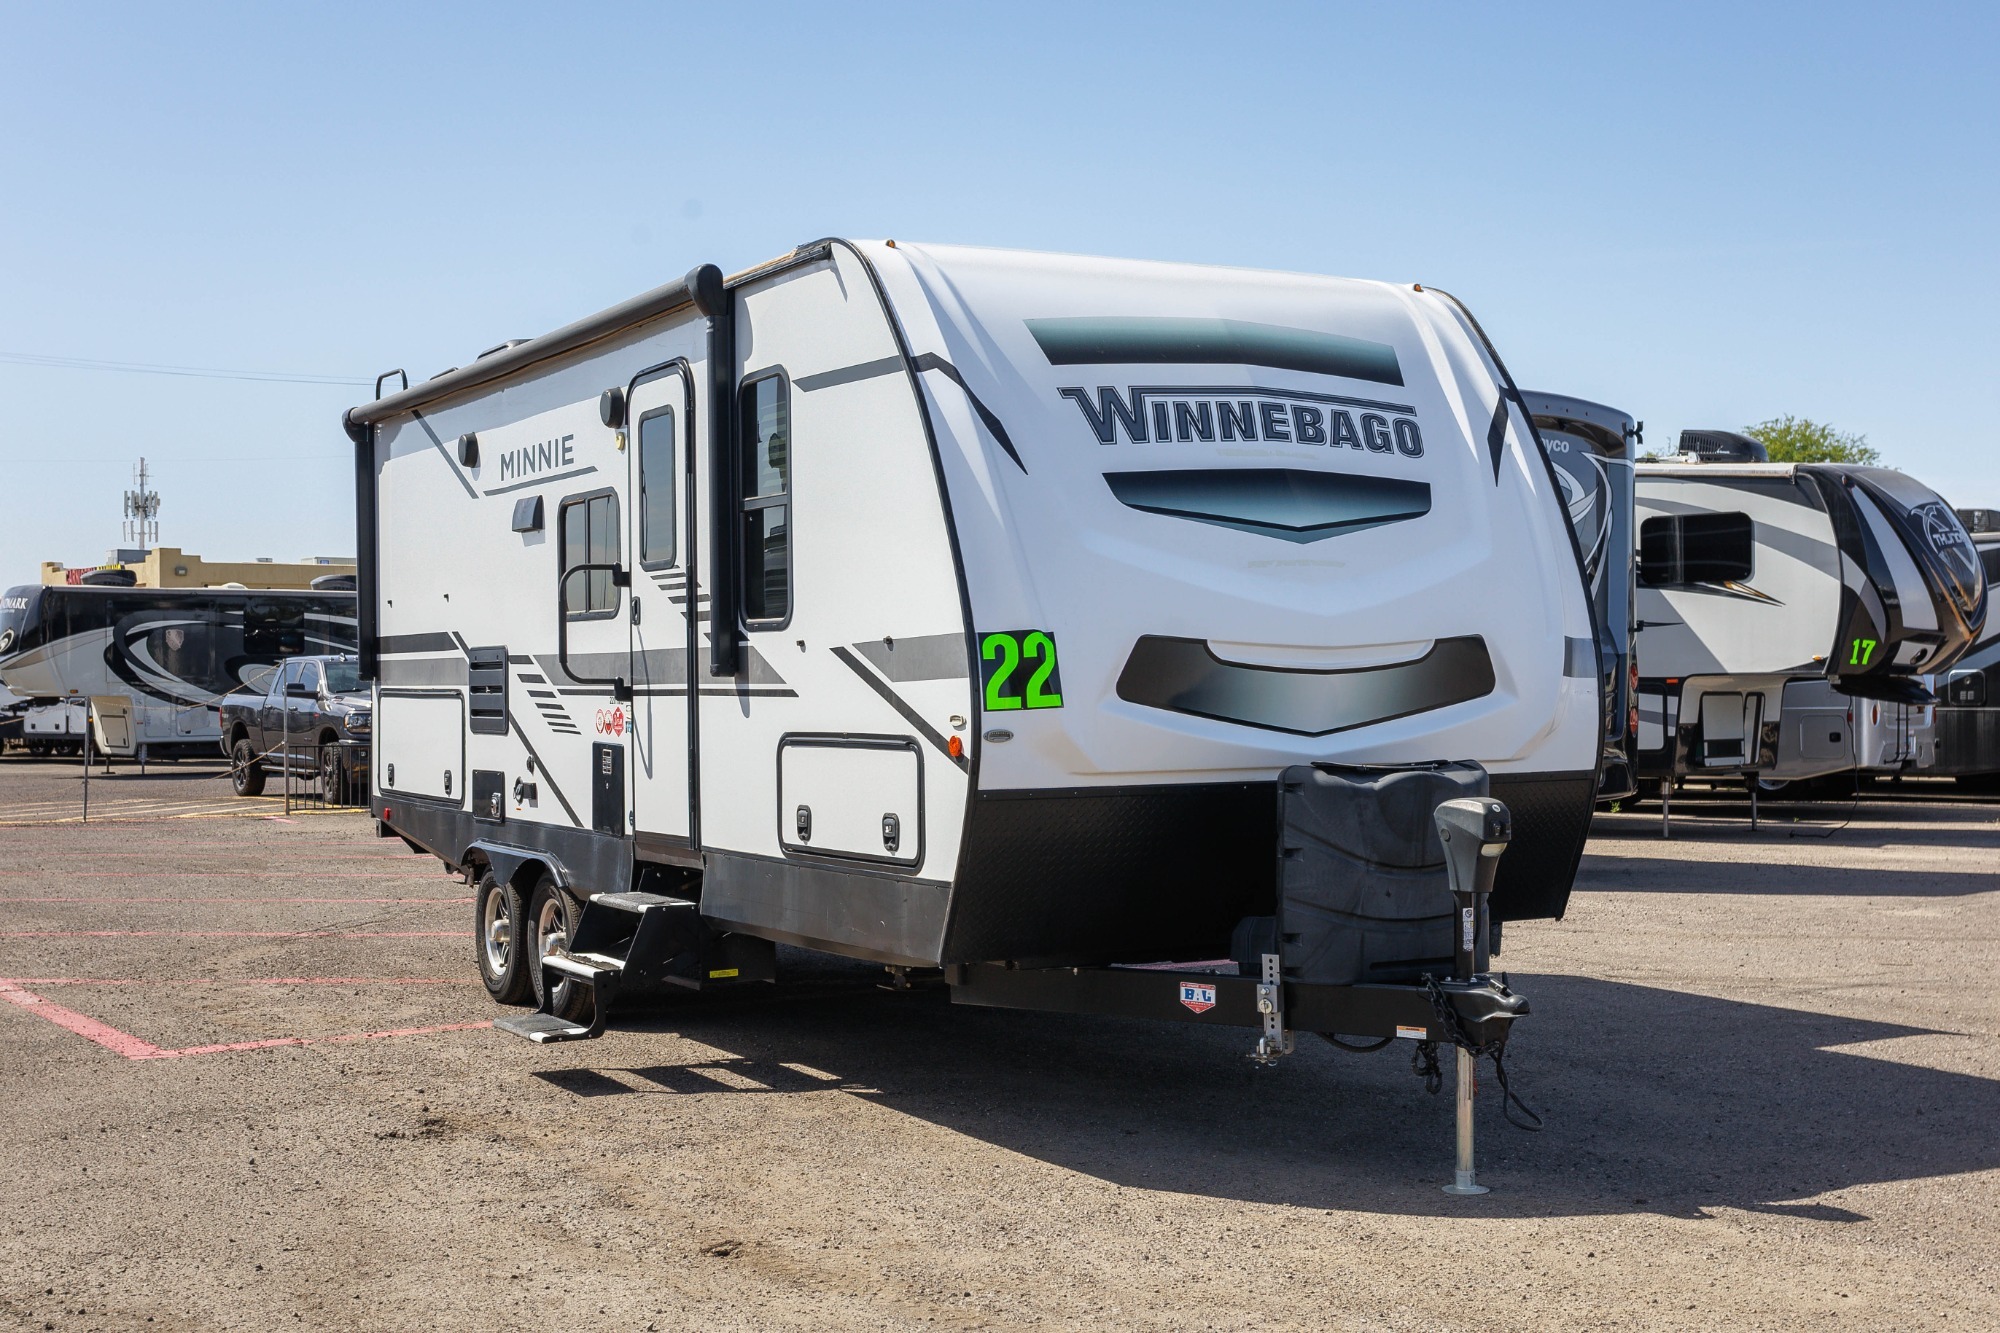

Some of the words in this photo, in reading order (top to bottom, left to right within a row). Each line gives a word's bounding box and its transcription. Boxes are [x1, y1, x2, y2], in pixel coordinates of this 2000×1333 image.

[1056, 385, 1424, 459] WINNEBAGO
[1541, 437, 1570, 454] yco
[500, 433, 574, 481] MINNIE
[982, 631, 1062, 711] 22
[1849, 638, 1877, 665] 17
